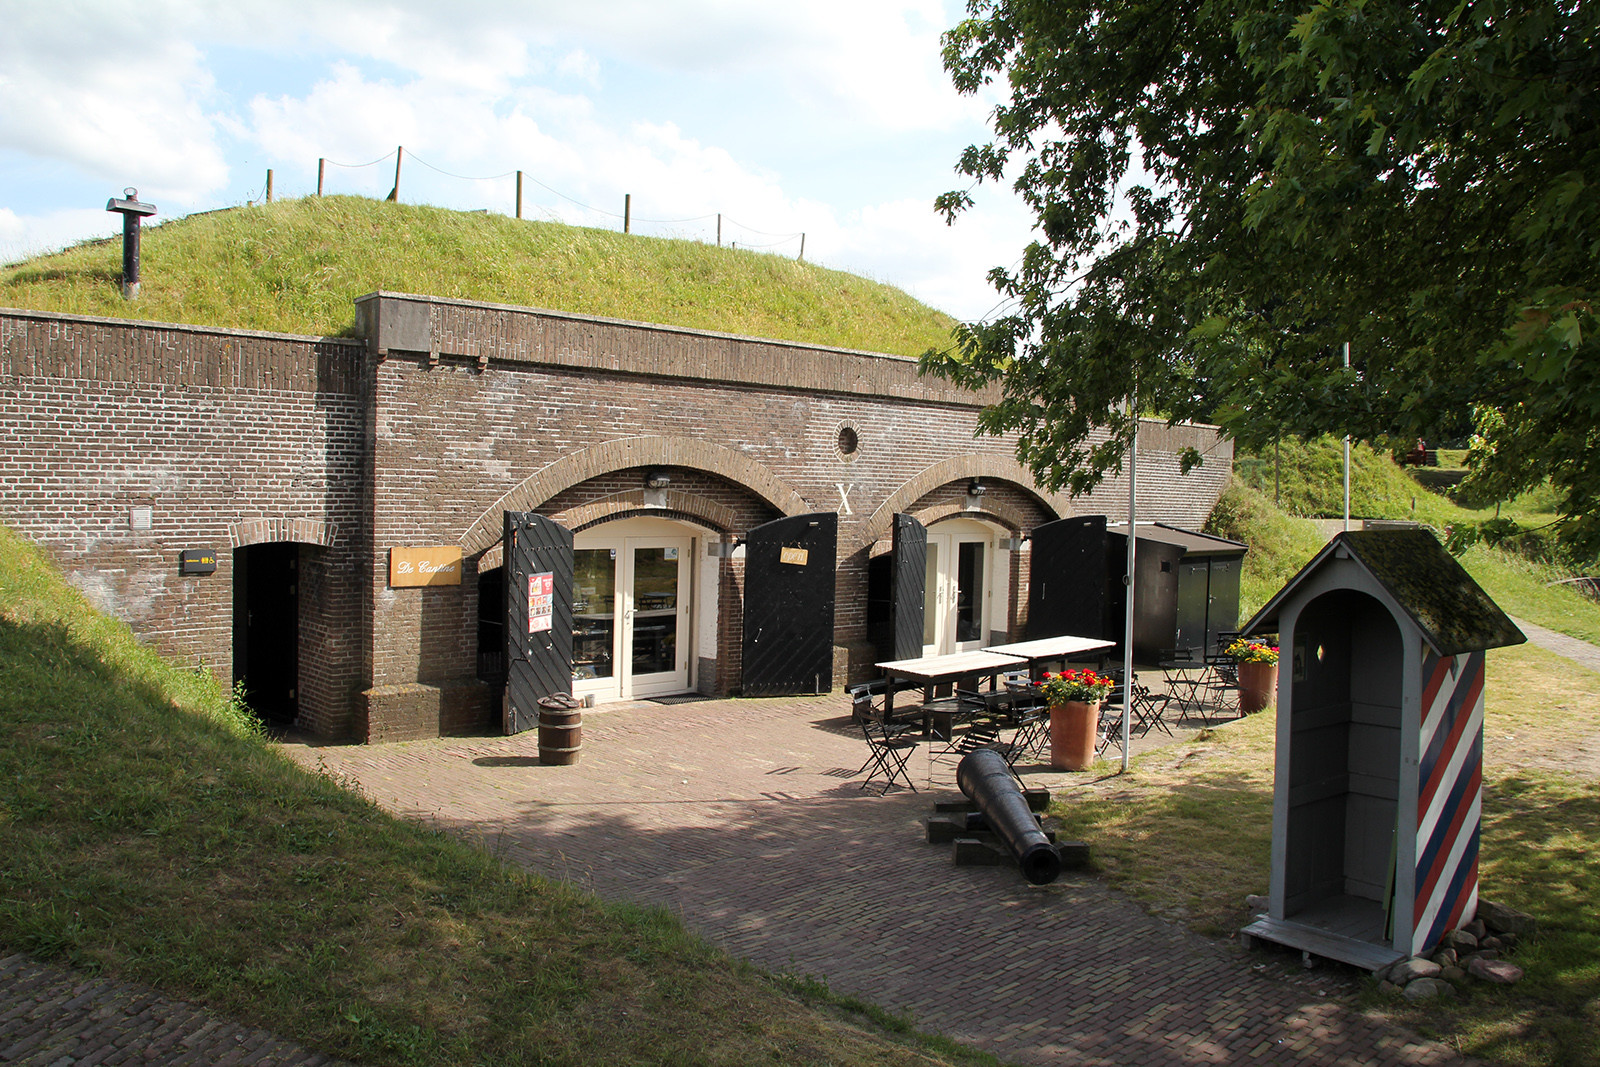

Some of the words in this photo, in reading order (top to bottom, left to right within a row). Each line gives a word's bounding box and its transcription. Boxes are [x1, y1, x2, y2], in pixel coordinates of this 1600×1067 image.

[835, 483, 854, 515] X
[397, 561, 415, 574] De
[417, 560, 456, 574] Cantine
